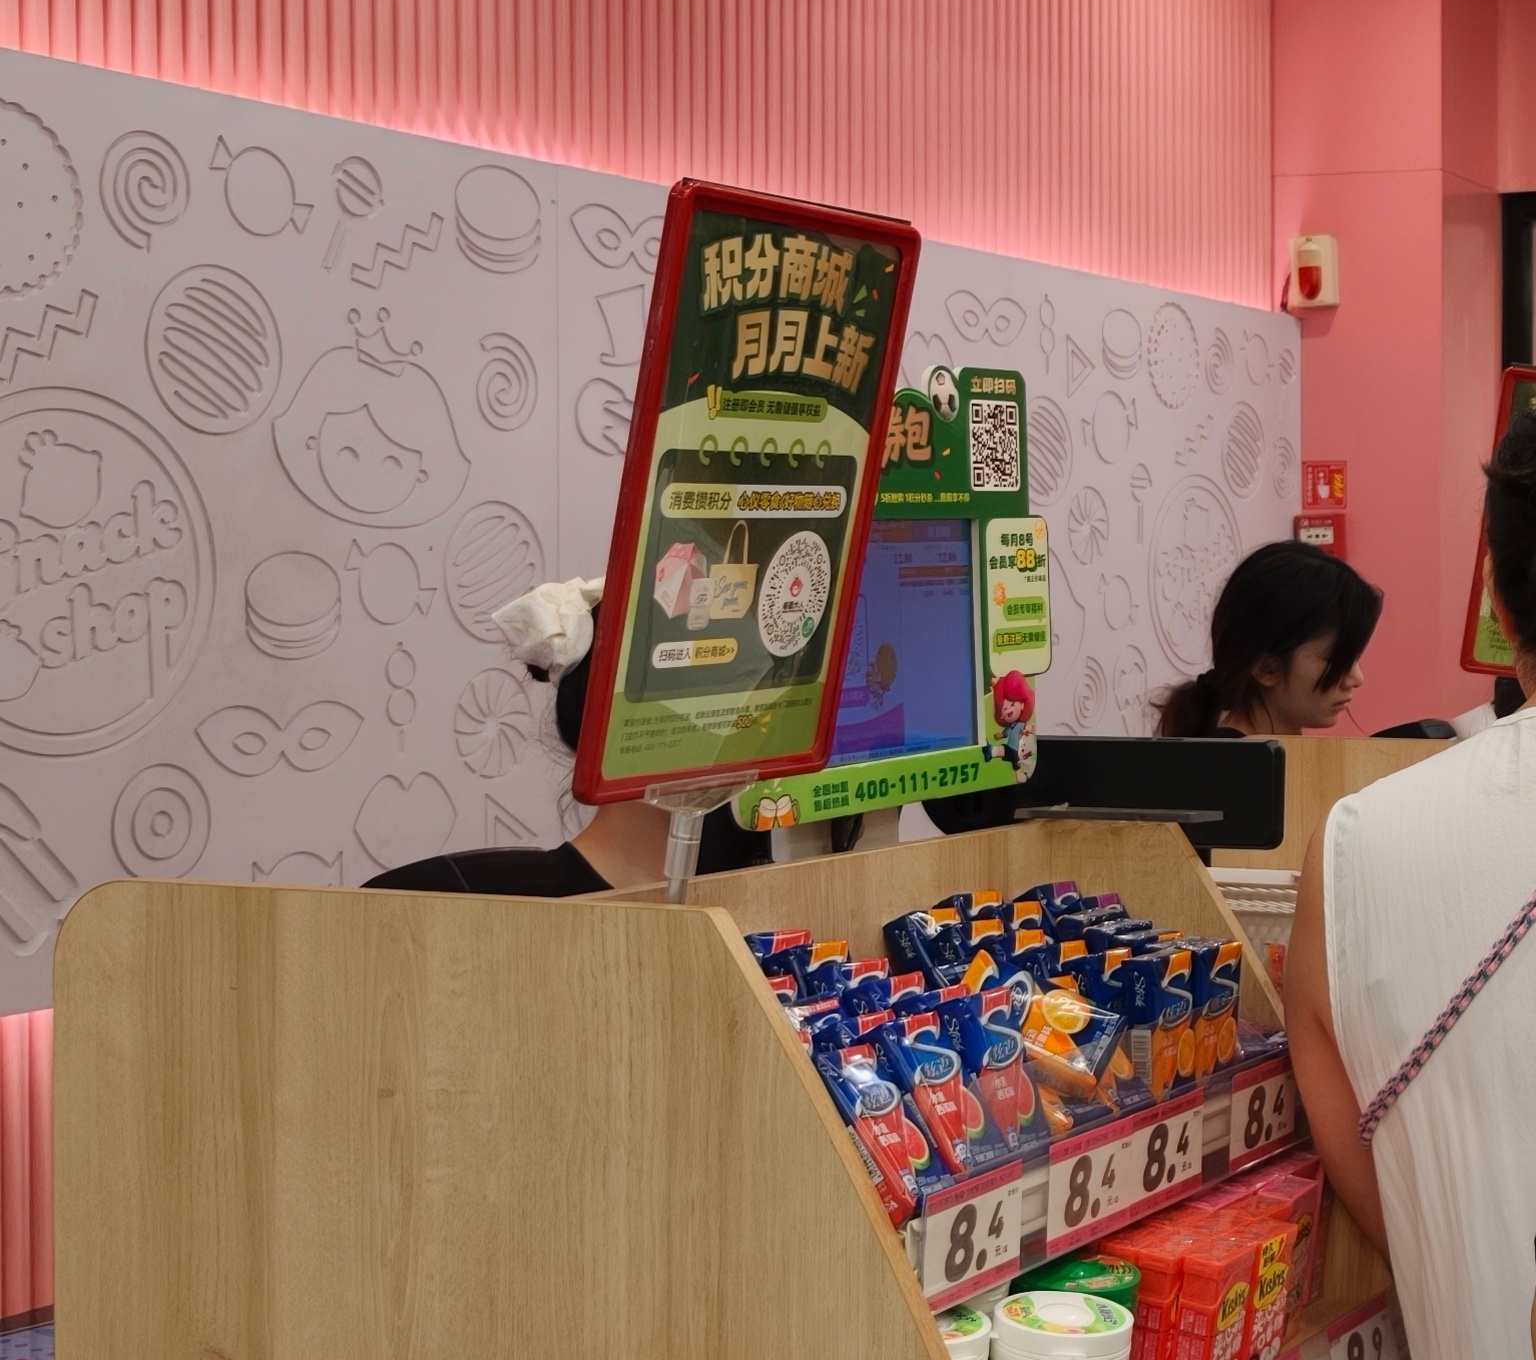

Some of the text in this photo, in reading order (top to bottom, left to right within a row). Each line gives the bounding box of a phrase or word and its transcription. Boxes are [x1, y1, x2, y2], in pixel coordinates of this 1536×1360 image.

[704, 234, 853, 316] 积分商城
[732, 310, 876, 393] 月月上新
[970, 376, 1017, 396] 立即扫码
[989, 548, 1046, 572] 会员享88折
[1000, 533, 1034, 547] 每月8号
[40, 577, 188, 697] shop
[855, 762, 980, 802] 400-111-2757
[1244, 1083, 1284, 1149] 8.4
[1064, 1153, 1117, 1228] 8.4
[1143, 1122, 1190, 1192] 8.4
[945, 1200, 1004, 1283] 8.4
